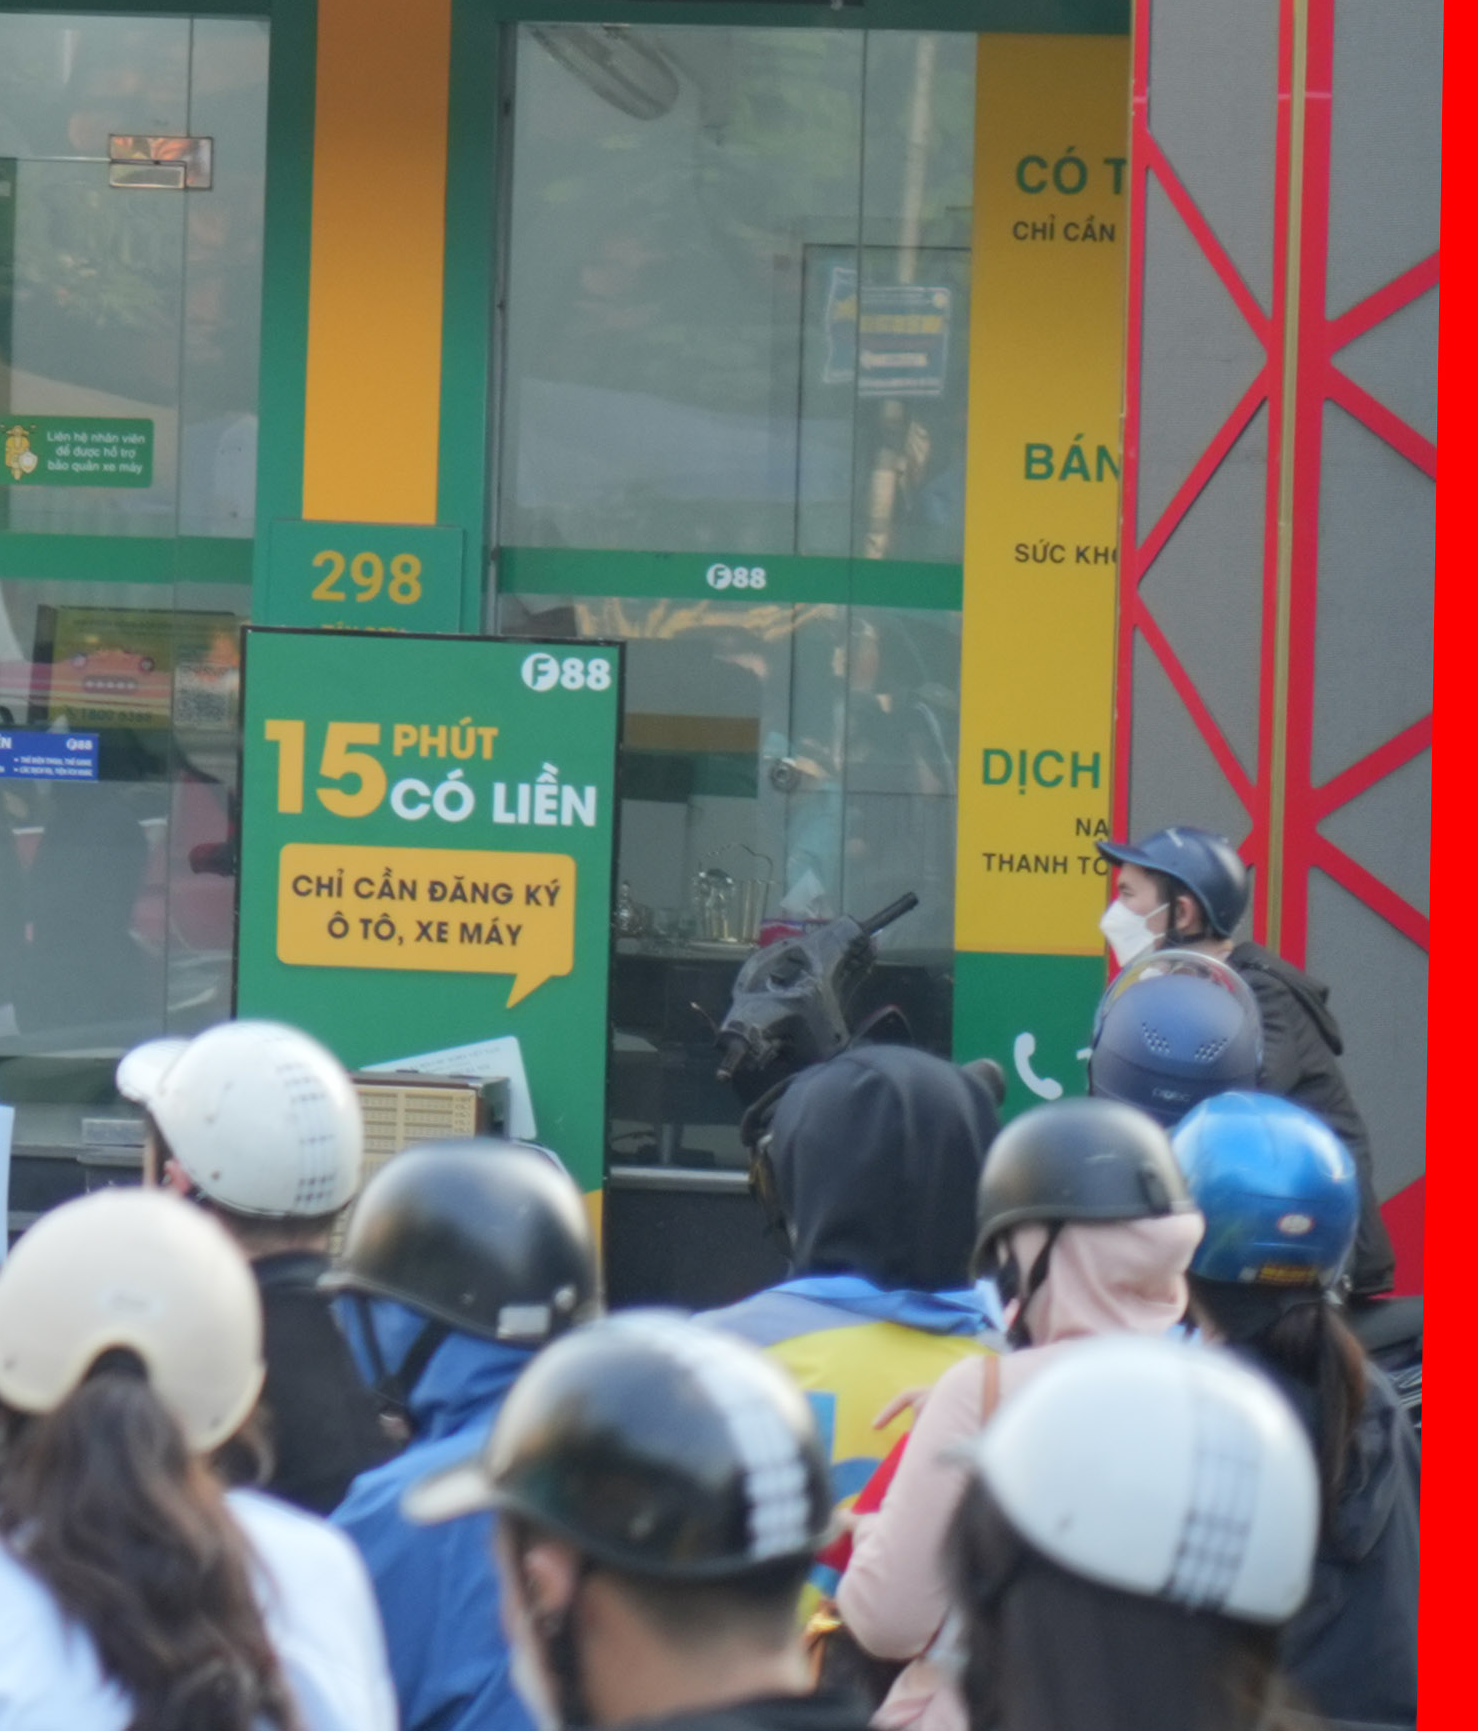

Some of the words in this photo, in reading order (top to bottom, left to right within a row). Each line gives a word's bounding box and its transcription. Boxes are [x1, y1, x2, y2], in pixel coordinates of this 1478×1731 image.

[1015, 146, 1088, 195] CÓ
[1012, 214, 1055, 242] CHỈ
[1063, 215, 1116, 243] CẦN
[1014, 539, 1065, 564] SỨC
[311, 551, 422, 605] 298
[522, 652, 611, 692] F88
[392, 717, 499, 760] PHÚT
[264, 719, 387, 819] 15
[982, 749, 1101, 795] DỊCH
[390, 769, 475, 822] CÓ
[492, 762, 597, 827] LIỀN
[982, 852, 1068, 874] THANH
[291, 868, 343, 899] CHỈ
[354, 866, 417, 901] CẦN
[428, 877, 513, 905] ĐĂNG
[525, 879, 561, 908] KÝ
[327, 912, 349, 940] Ô
[360, 913, 404, 945] TÔ,
[415, 919, 449, 943] XE
[459, 918, 523, 947] MÁY
